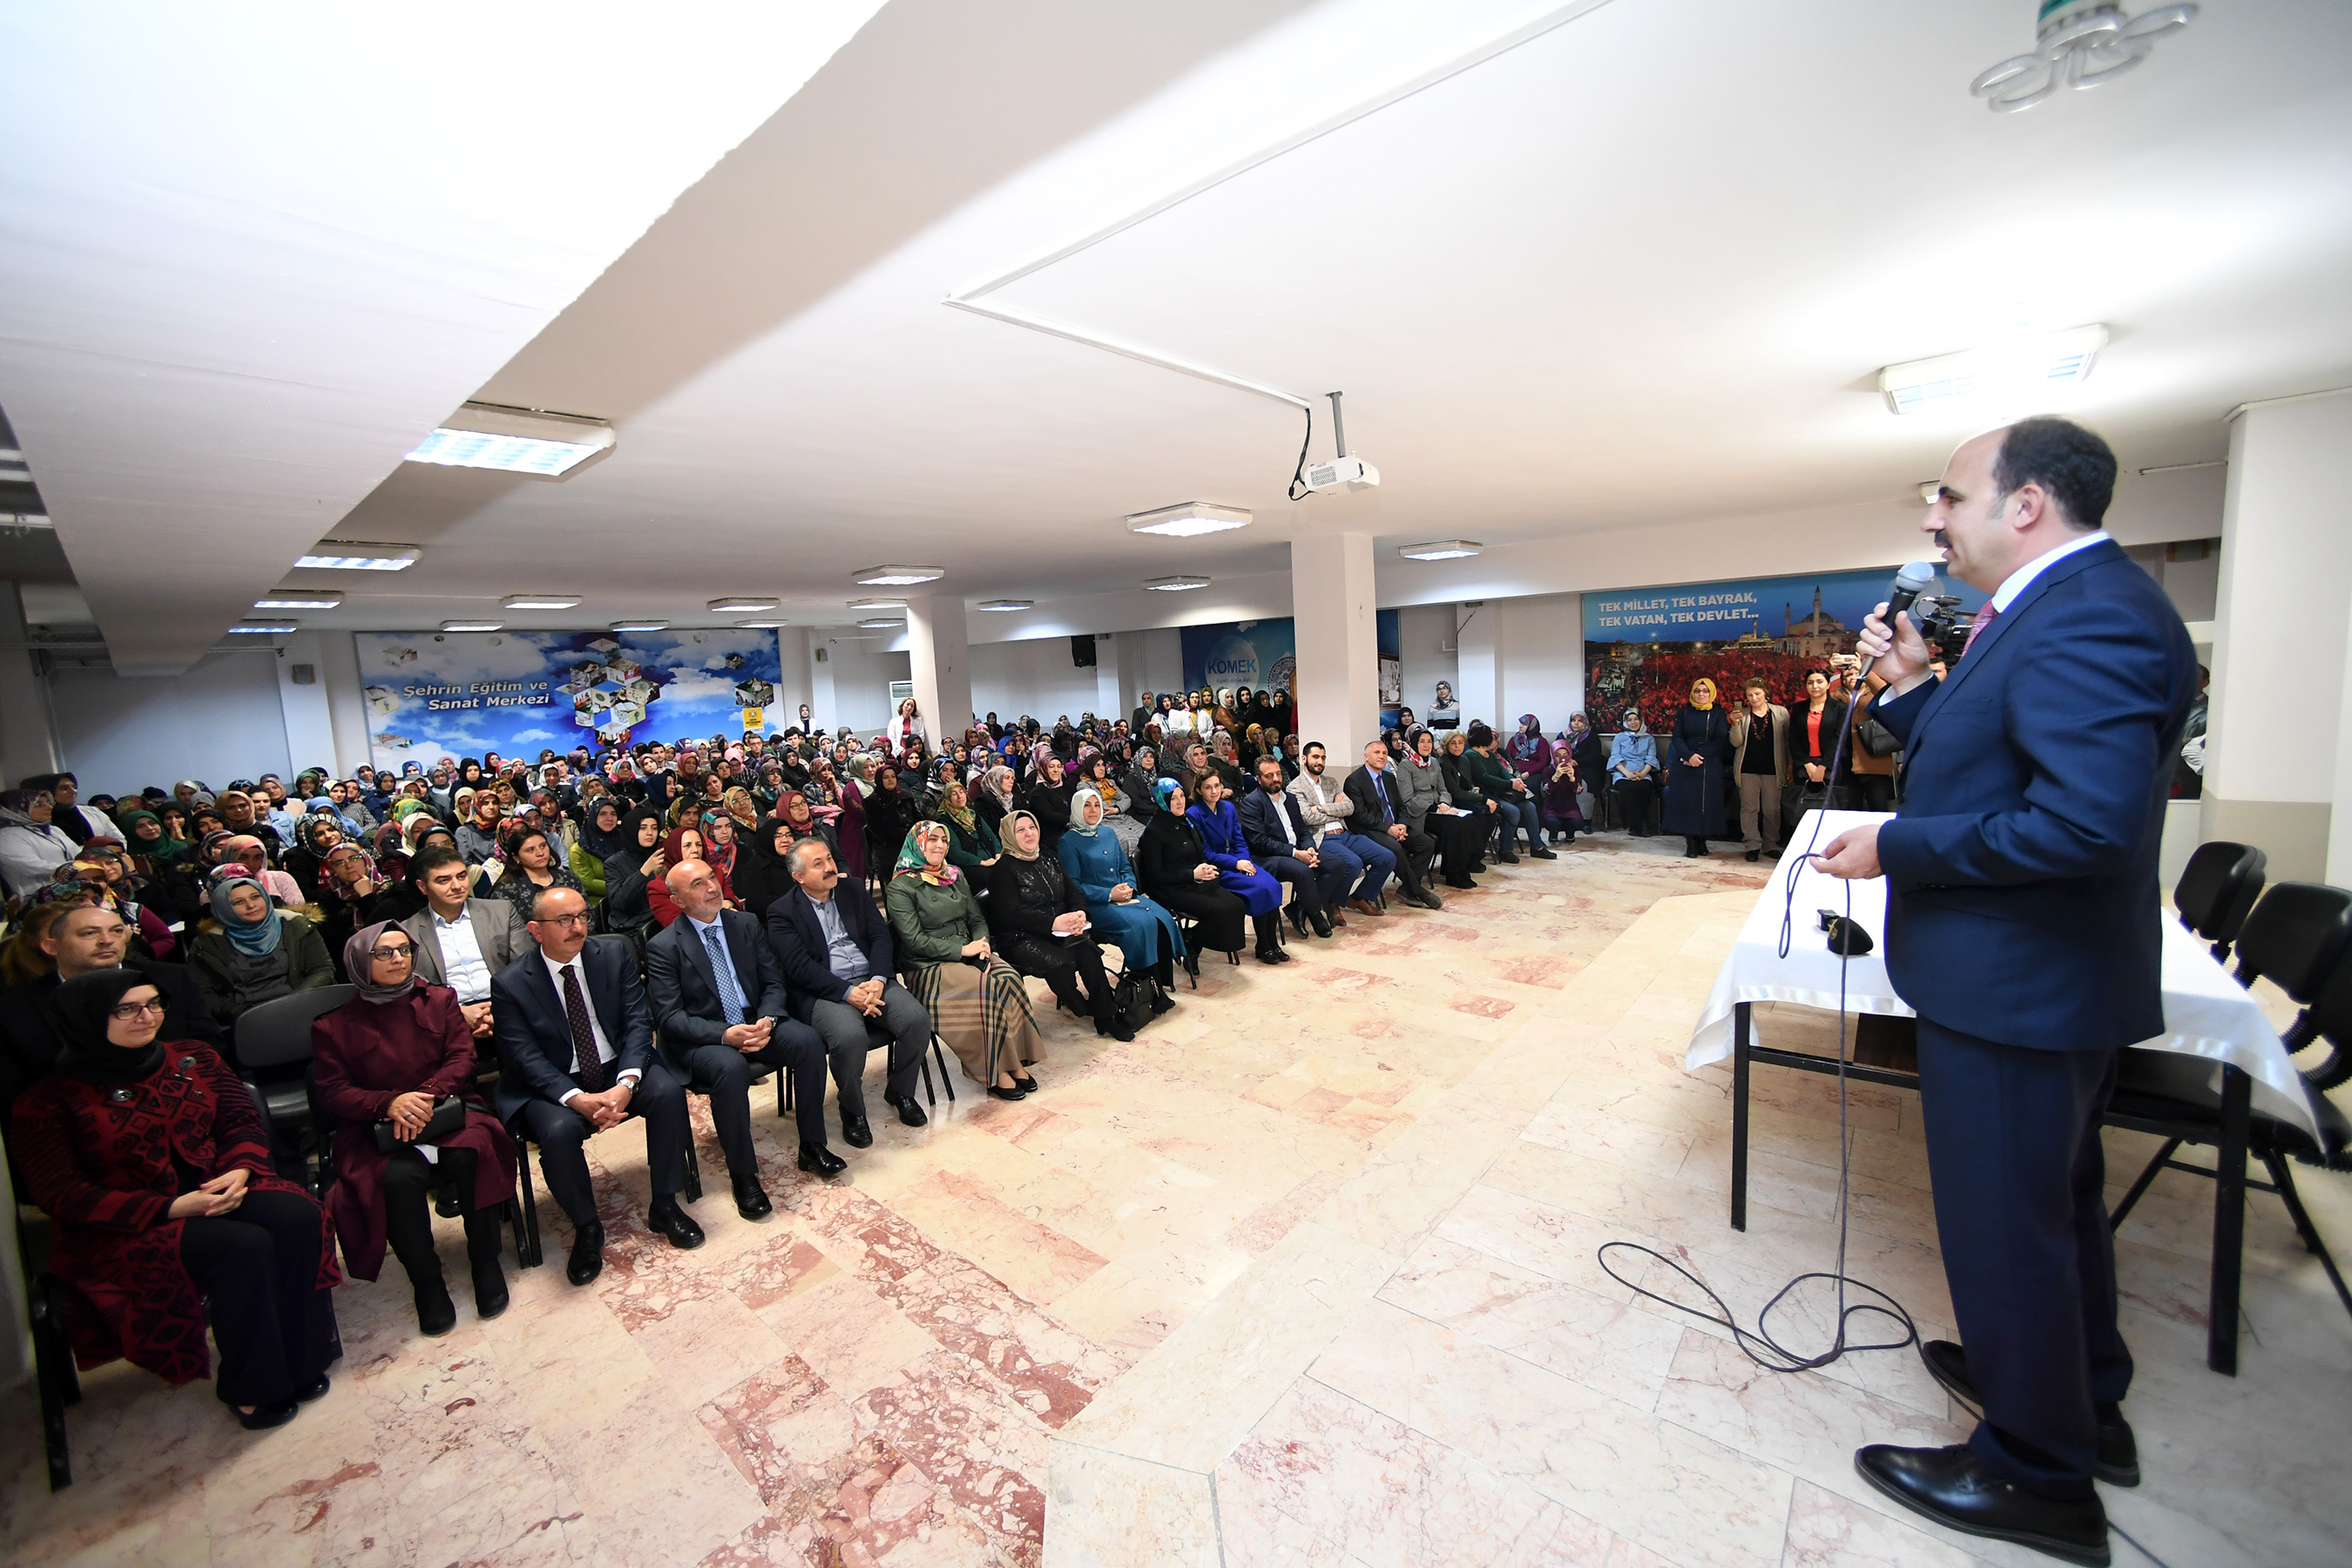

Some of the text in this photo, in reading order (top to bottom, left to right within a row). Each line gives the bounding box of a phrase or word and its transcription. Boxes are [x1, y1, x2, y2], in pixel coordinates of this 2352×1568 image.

[1598, 592, 1757, 612] TEK MİLLET, TEK BAYRAK,
[1599, 608, 1759, 627] TEK VATAN, TEK DEVLET...
[1208, 659, 1256, 674] KOMEK
[403, 681, 548, 698] Şehrin Eğitim ve
[428, 693, 550, 710] Sanat Merkezi
